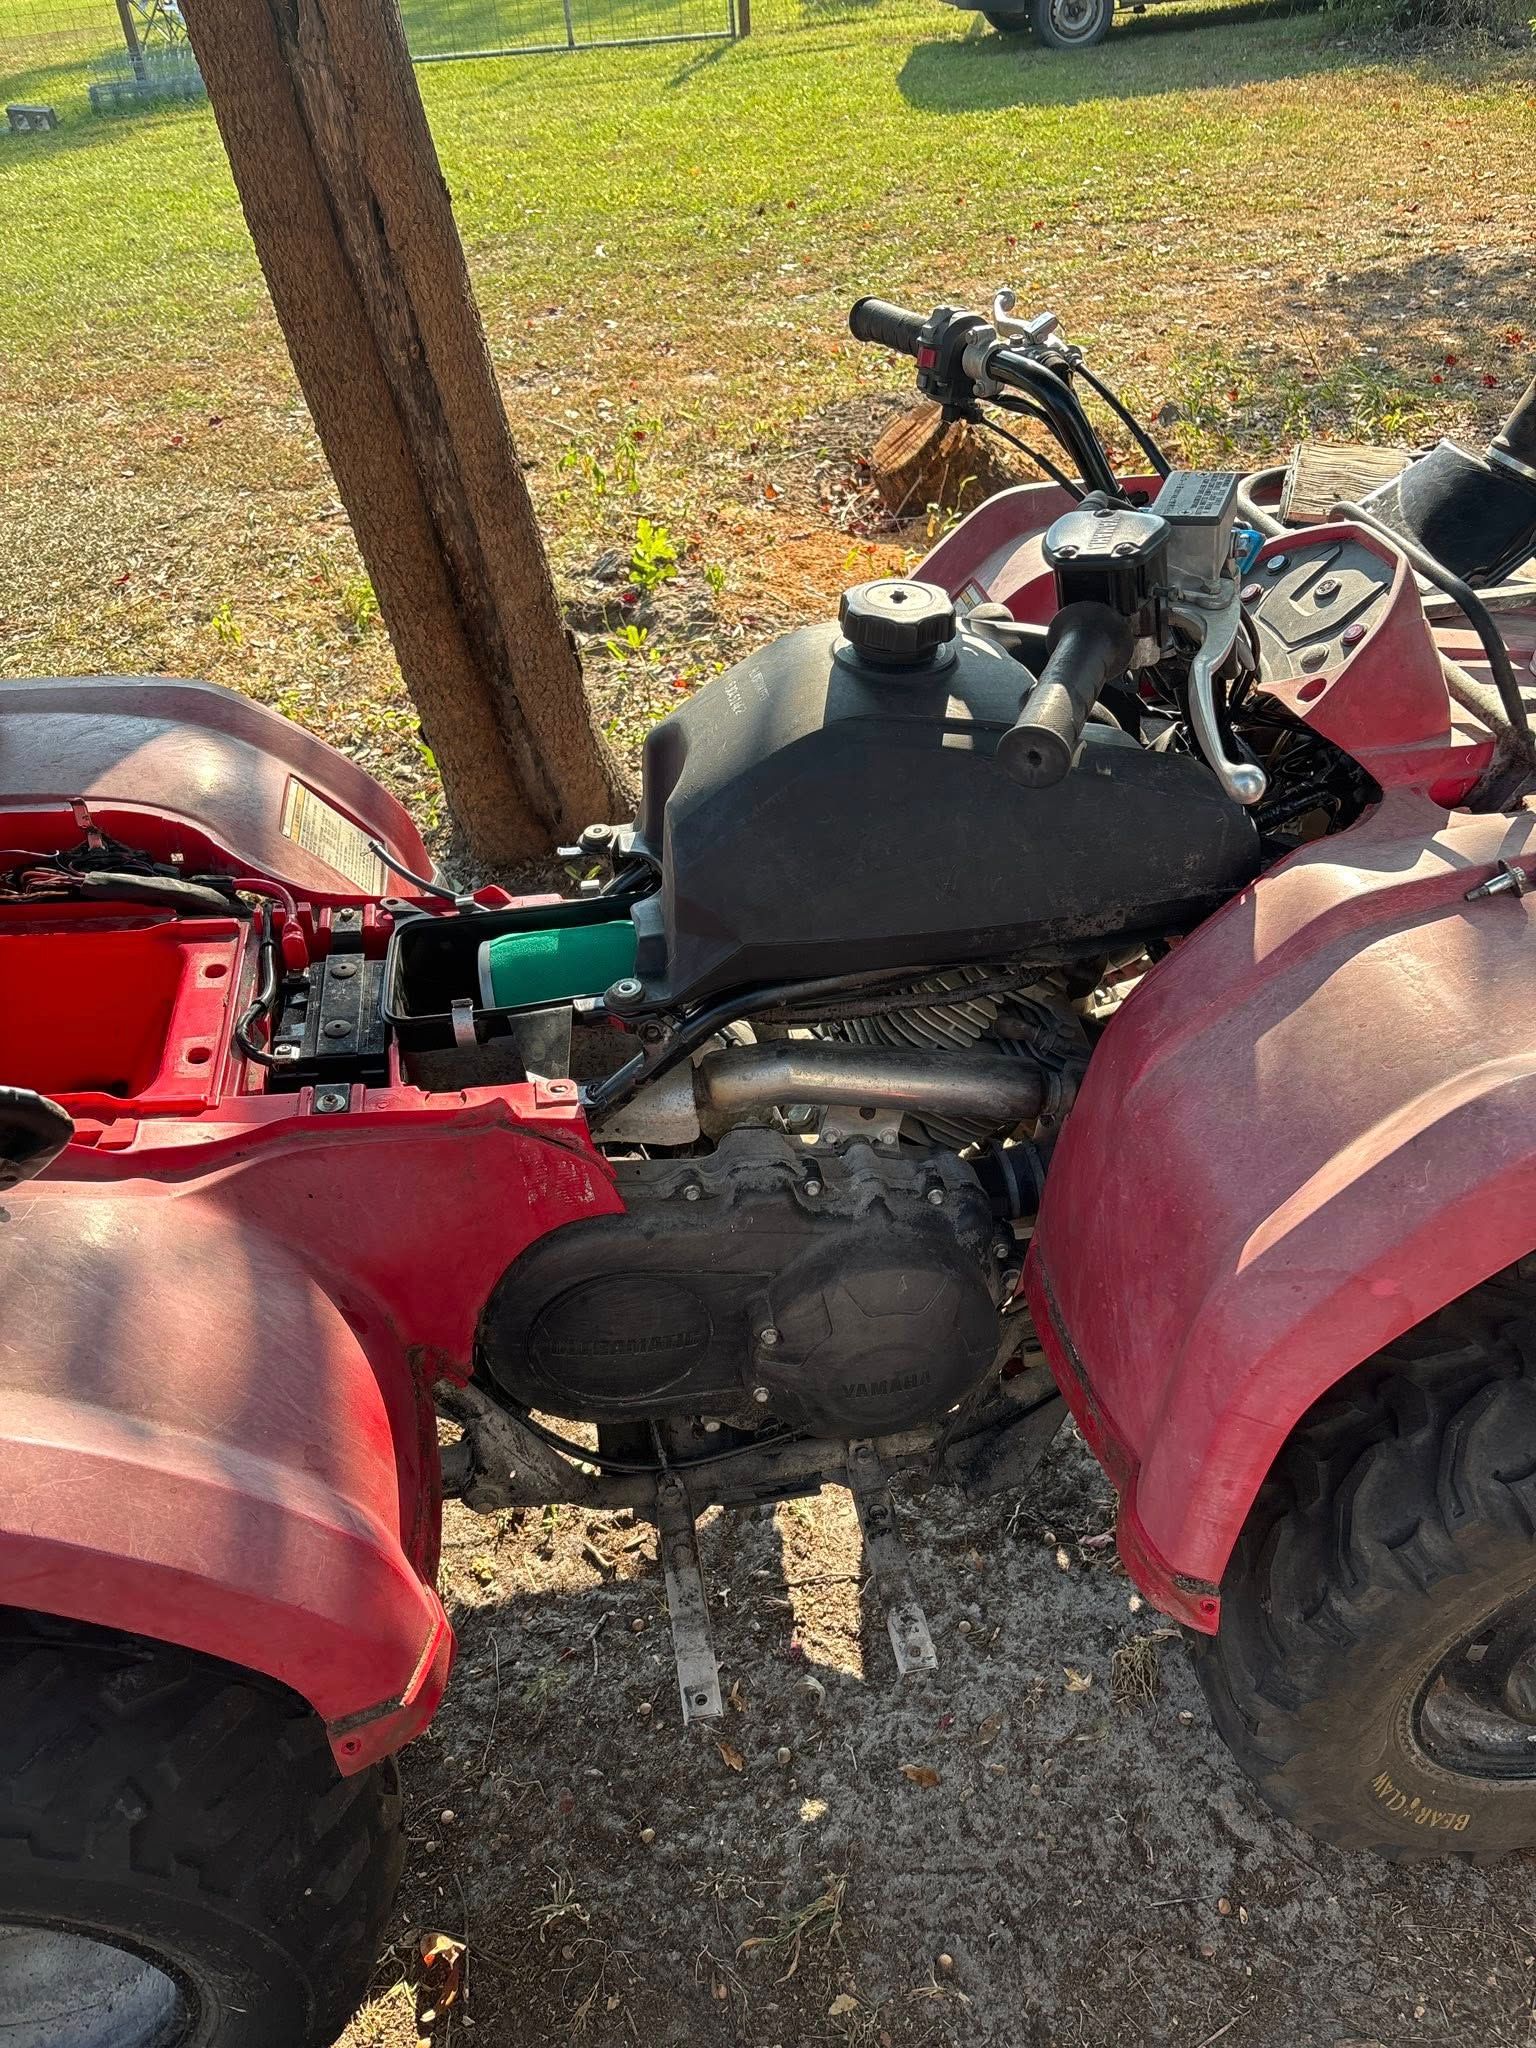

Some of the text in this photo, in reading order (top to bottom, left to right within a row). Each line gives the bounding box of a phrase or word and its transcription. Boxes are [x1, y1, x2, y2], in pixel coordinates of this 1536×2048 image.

[841, 1369, 931, 1398] YAMAHA
[1371, 1770, 1470, 1831] BEAR CLAW
